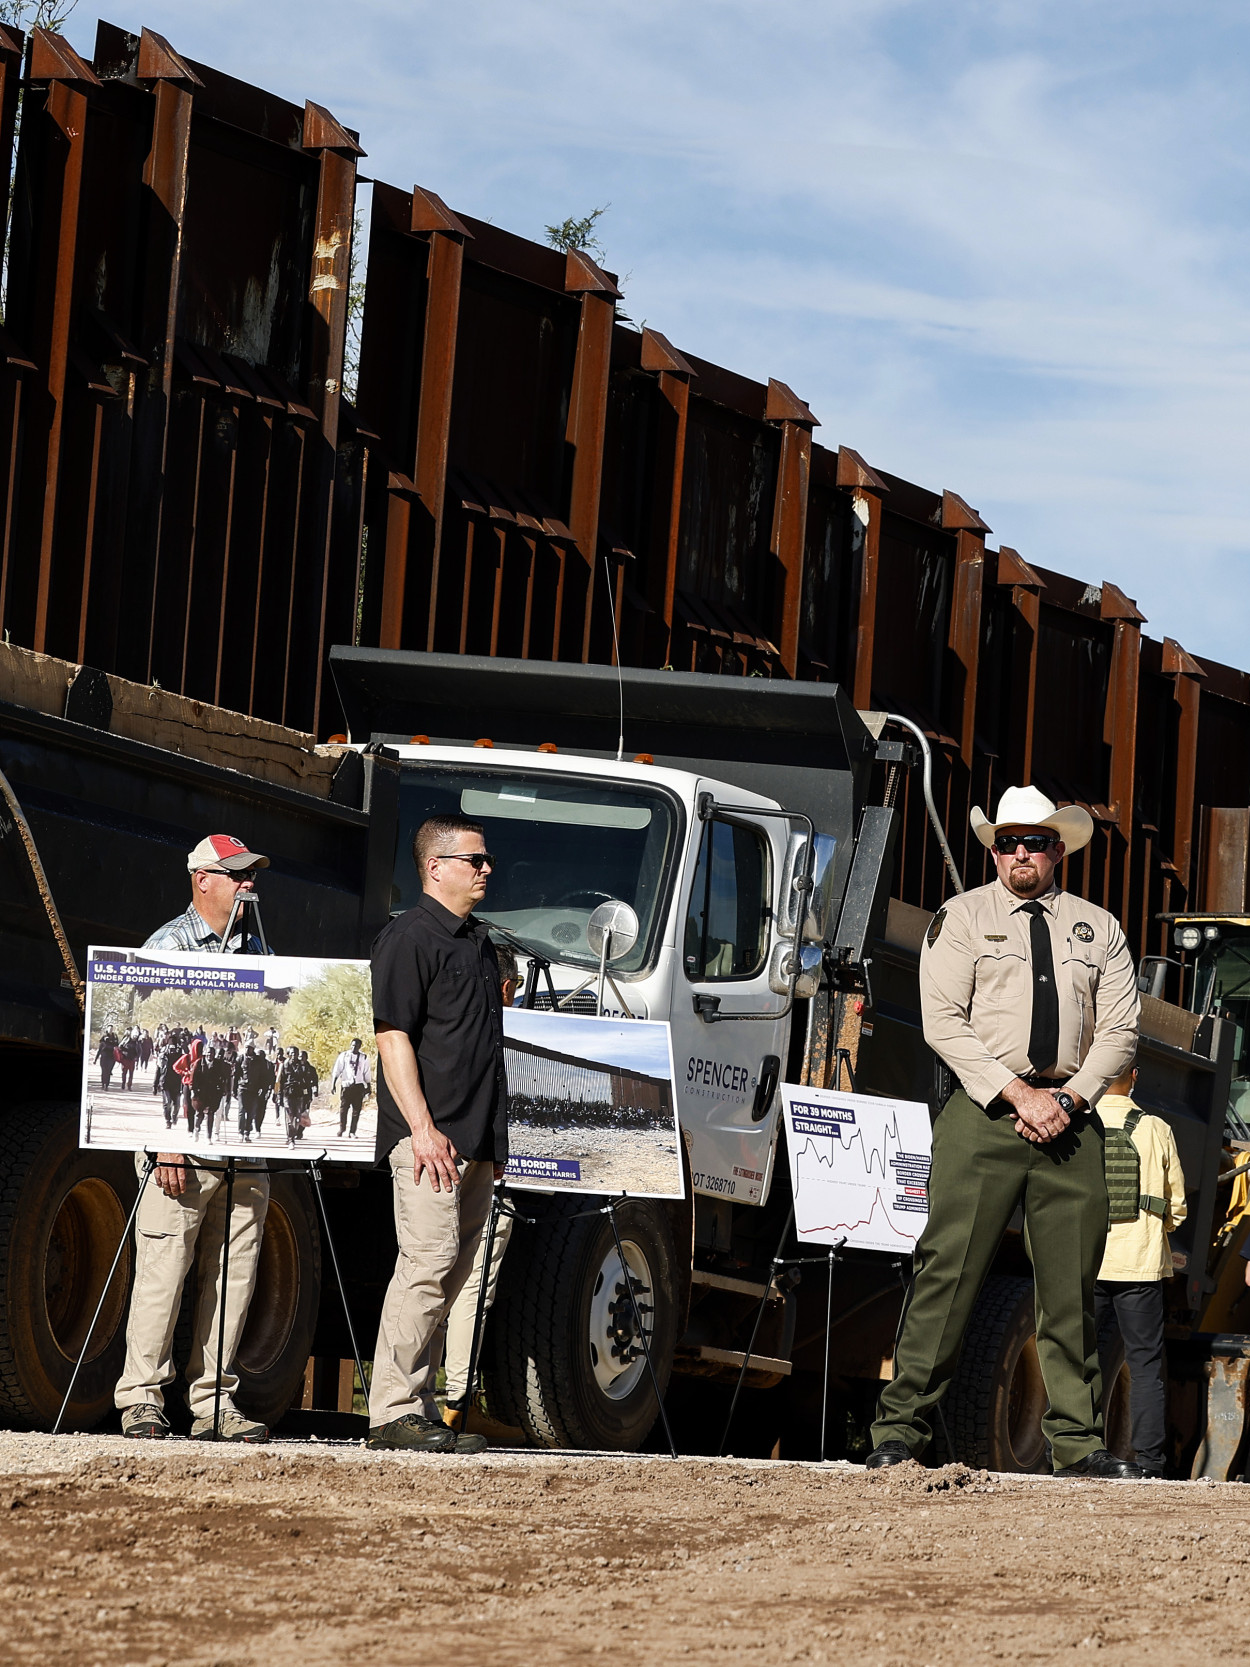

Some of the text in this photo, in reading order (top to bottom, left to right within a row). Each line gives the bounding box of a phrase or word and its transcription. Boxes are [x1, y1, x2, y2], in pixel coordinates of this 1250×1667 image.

[94, 963, 236, 981] U.S. SOUTHERN BORDER
[93, 973, 259, 990] UNDER BORDER CZAR KAMALA HARRIS
[687, 1056, 749, 1093] SPENCER
[684, 1085, 746, 1104] CONSTRUCTION
[792, 1104, 853, 1121] FOR 39 MONTHS
[795, 1121, 839, 1136] STRAIGHT...
[504, 1166, 577, 1179] CZAR KAMALA HARRIS
[520, 1159, 558, 1170] BORDER
[706, 1175, 736, 1195] 3268710
